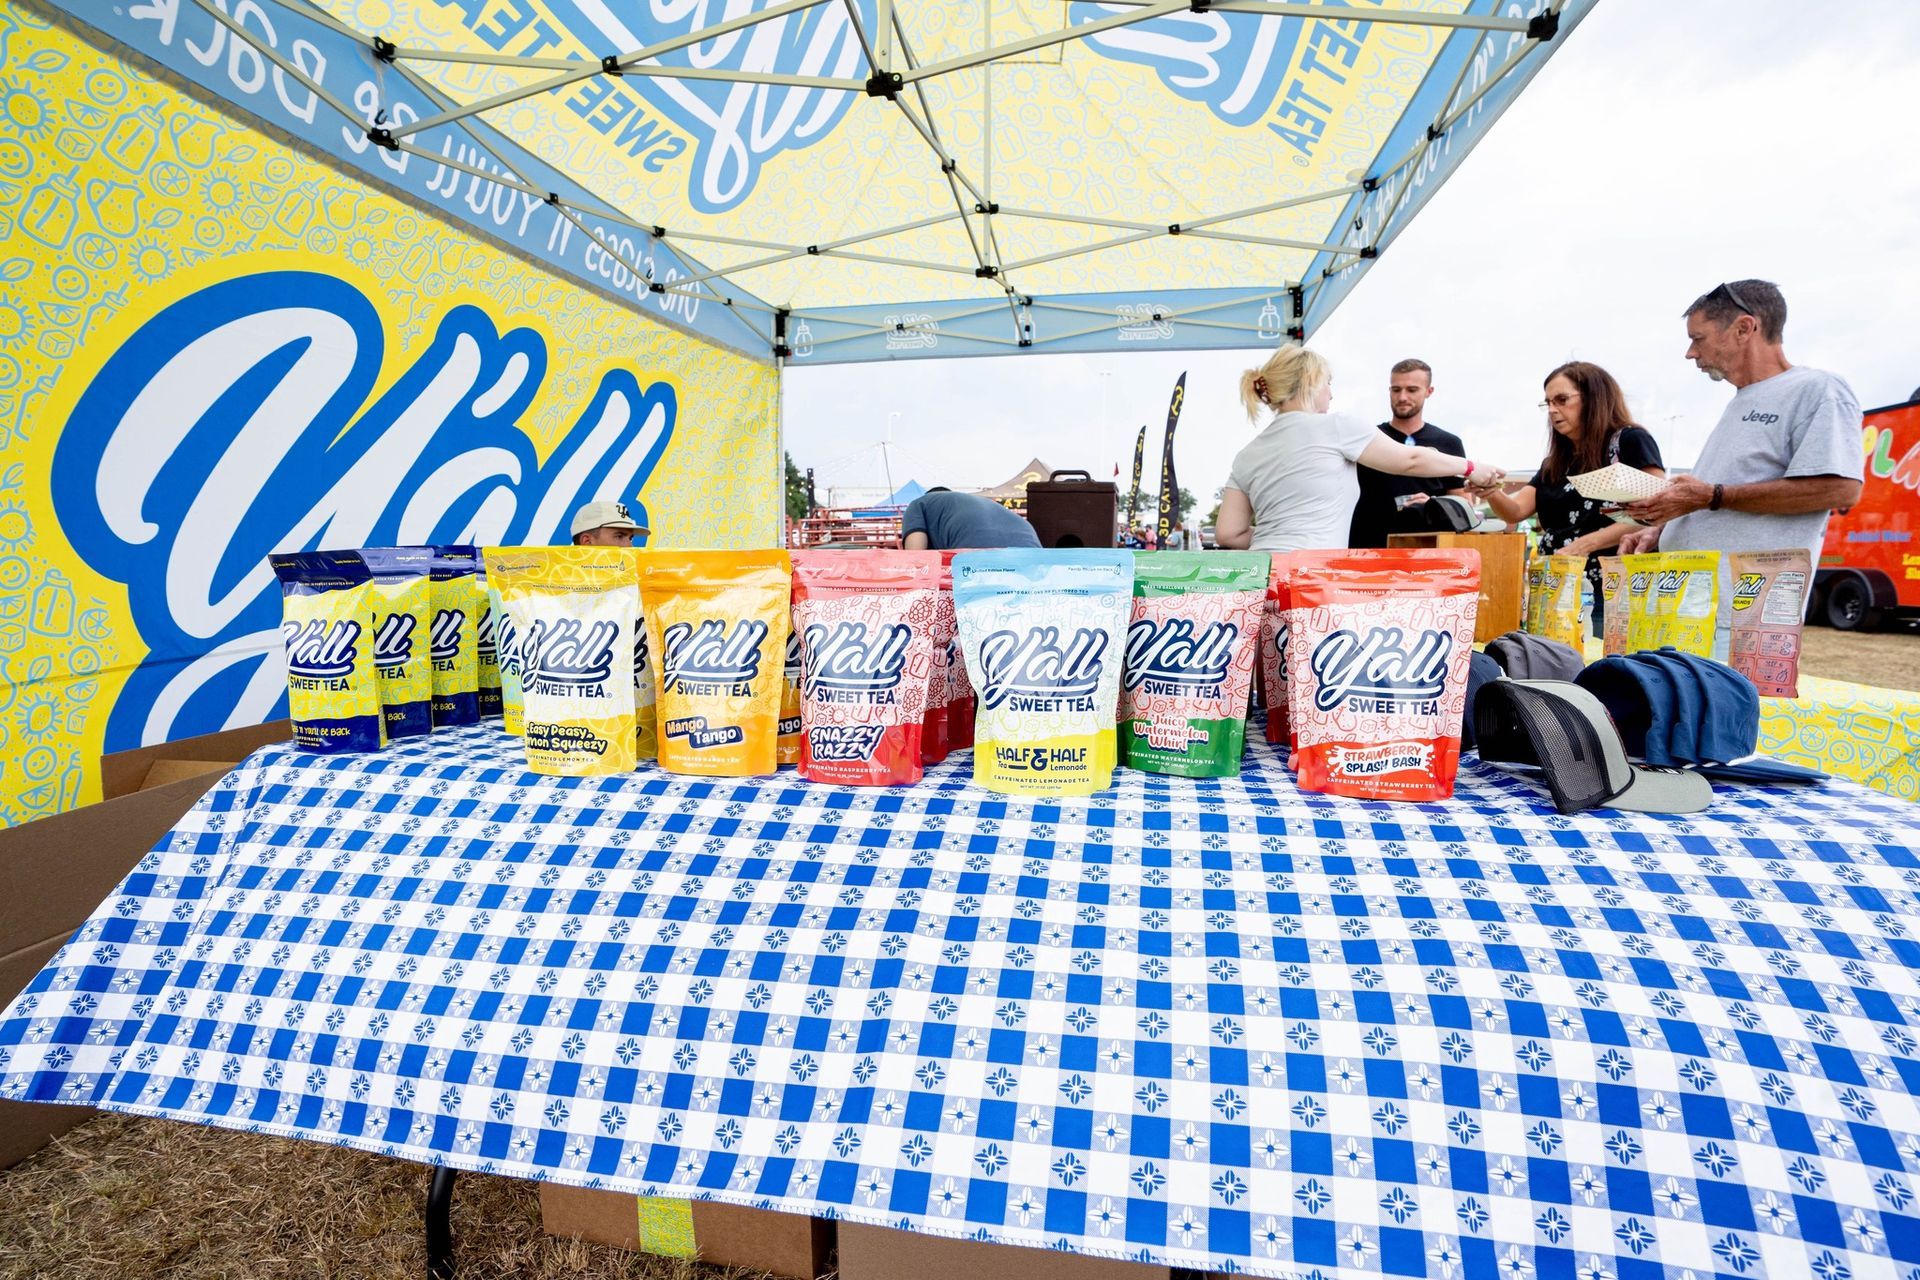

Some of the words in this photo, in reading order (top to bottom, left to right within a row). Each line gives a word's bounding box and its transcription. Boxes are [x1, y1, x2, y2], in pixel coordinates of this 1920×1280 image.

[1742, 409, 1779, 426] Jeep
[479, 655, 498, 666] TEA
[522, 620, 618, 690] Y'all
[664, 621, 766, 692] Y'all
[805, 623, 911, 700] Y'all
[1125, 620, 1235, 691] Y'all
[379, 667, 406, 679] TEA
[432, 660, 455, 671] TEA
[980, 627, 1107, 709] Y'all
[1312, 628, 1451, 712] Y'all
[290, 676, 320, 690] SWEET
[323, 678, 350, 691] TEA
[536, 681, 574, 697] SWEET
[577, 683, 605, 698] TEA
[677, 681, 721, 696] SWEET
[724, 683, 752, 698] TEA
[1144, 680, 1191, 697] SWEET
[1194, 684, 1221, 699] TEA
[817, 687, 863, 703] SWEET
[867, 689, 895, 705] TEA
[1009, 696, 1063, 712] SWEET
[1067, 696, 1095, 712] TEA
[1349, 697, 1407, 714] SWEET
[1410, 700, 1438, 716] TEA
[529, 723, 549, 734] Easy
[666, 718, 705, 735] Mango
[1152, 715, 1186, 729] Juicy
[694, 727, 736, 745] Tango
[811, 726, 883, 744] SNAZZY
[1134, 722, 1208, 740] Watermelon
[551, 738, 606, 754] Squeezy
[814, 742, 874, 760] RAZZY
[1150, 735, 1187, 750] Whirl
[996, 747, 1031, 762] HALF
[1030, 748, 1049, 771] &
[1051, 748, 1087, 763] HALF
[1160, 755, 1202, 764] WATERMELON
[1344, 745, 1421, 762] STRAWBERRY
[998, 760, 1007, 769] Tea
[1050, 763, 1087, 771] Lemonade
[1345, 759, 1389, 773] SPLASH
[1391, 756, 1421, 768] BASH
[994, 775, 1038, 784] CAFFEINATED
[1327, 777, 1374, 786] CAFFEINATED
[1374, 781, 1423, 789] STRAWBERRY
